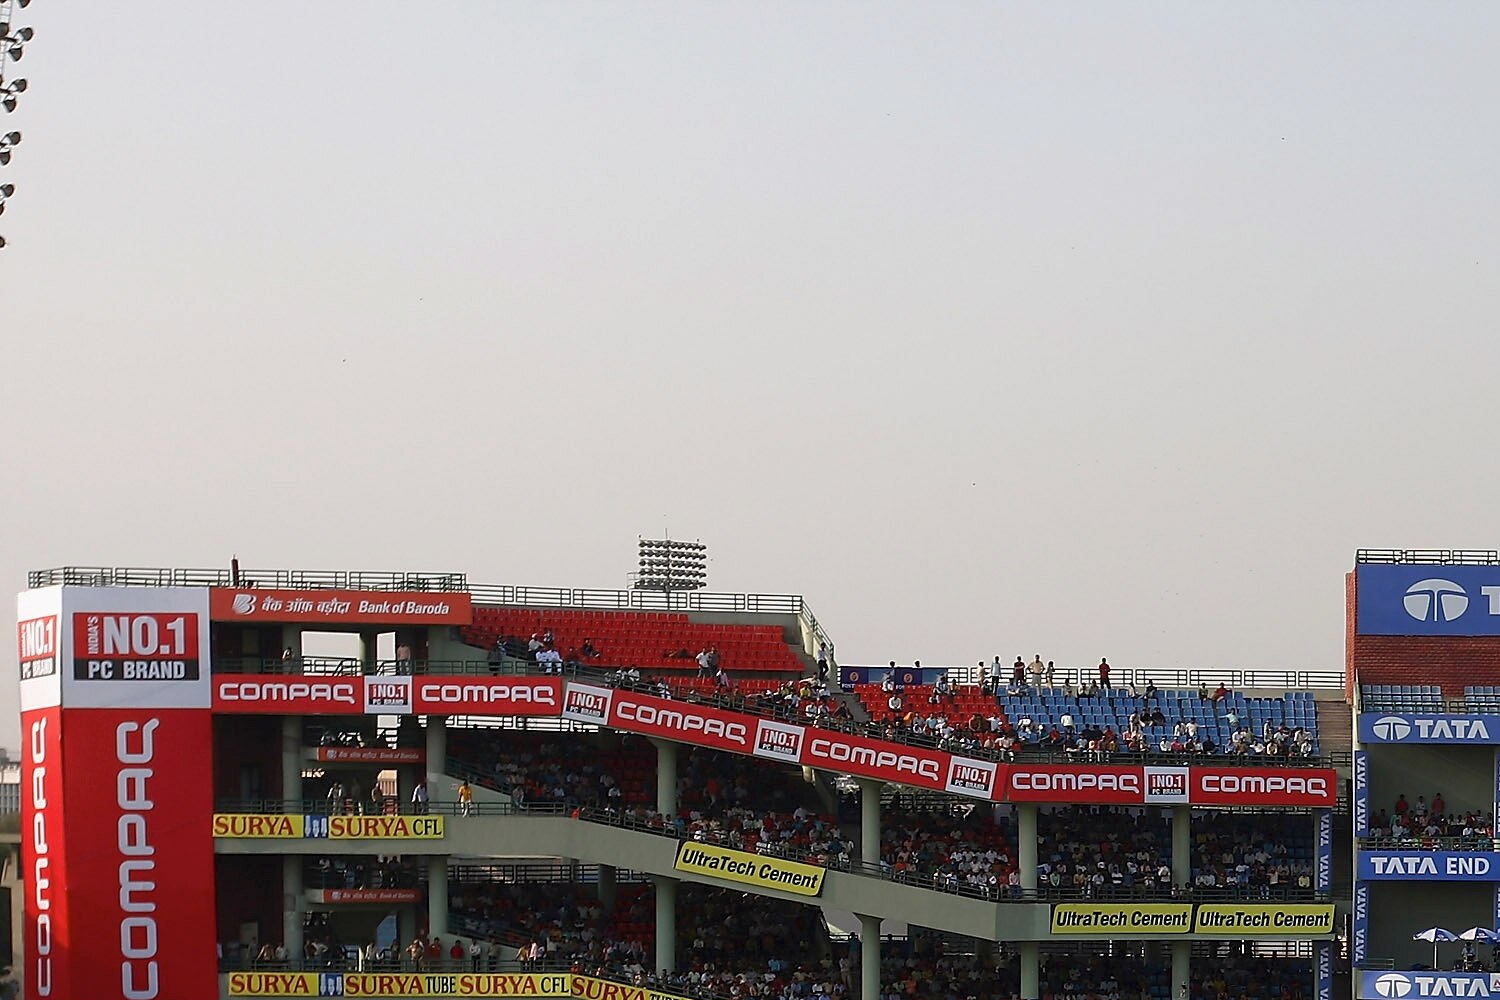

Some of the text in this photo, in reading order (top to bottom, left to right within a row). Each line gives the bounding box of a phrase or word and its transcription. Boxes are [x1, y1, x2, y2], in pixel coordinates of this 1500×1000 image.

[358, 600, 450, 614] Bank of Baroda
[88, 616, 99, 654] INDIA'S
[102, 616, 185, 656] NO.1
[88, 661, 185, 679] PC BRAND
[218, 682, 355, 704] COMPAQ
[421, 684, 556, 706] COMPAQ
[616, 700, 746, 745] COMPAQ
[1415, 719, 1490, 740] TATA
[810, 738, 939, 781] COMPAQ
[1012, 772, 1140, 794] COMPAQ
[1357, 756, 1366, 790] TATA
[1201, 775, 1328, 797] COMPAQ
[214, 817, 442, 838] SURYA SURYA CFL
[31, 717, 50, 996] COMPAQ
[116, 718, 160, 1000] COMPAQ
[1371, 856, 1490, 876] TATA END
[681, 848, 818, 890] UltraTech Cement
[1056, 910, 1188, 927] UltraTech Cement
[1200, 911, 1330, 928] UltraTech Cement
[230, 974, 310, 995] SURYA
[345, 974, 425, 996] SURYA
[425, 976, 456, 994] TUBE
[460, 975, 538, 995] SURYA
[541, 976, 569, 994] CFL
[1415, 976, 1490, 998] TATA
